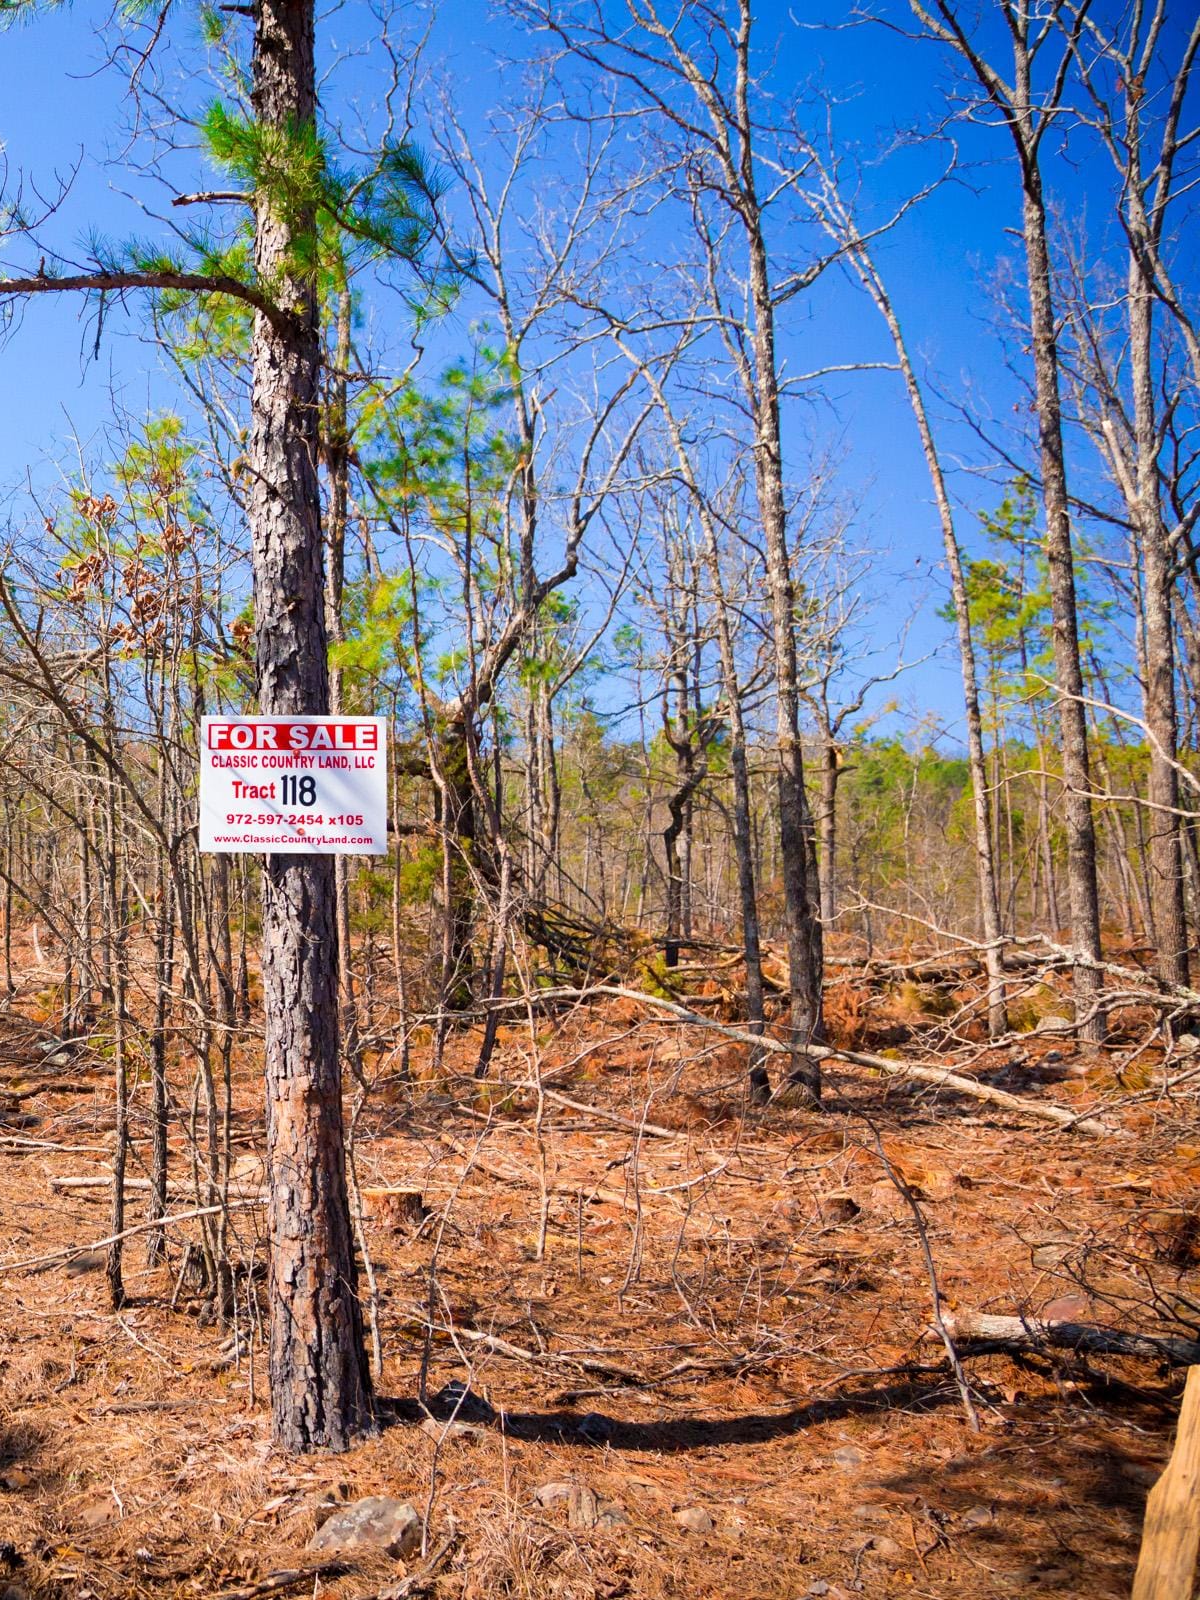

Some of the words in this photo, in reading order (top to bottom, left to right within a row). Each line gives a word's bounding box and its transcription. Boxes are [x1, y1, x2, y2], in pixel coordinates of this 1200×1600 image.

[210, 725, 278, 749] FOR
[289, 725, 376, 749] SALE
[211, 755, 258, 768] CLASSIC
[261, 755, 315, 769] COUNTRY
[318, 756, 352, 772] LAND,
[355, 756, 375, 769] LLC
[232, 781, 276, 799] Tract
[281, 774, 317, 807] 118
[226, 814, 323, 825] 972-597-2454
[328, 815, 364, 826] x105
[214, 834, 373, 846] www.ClassicCountryLand.com
